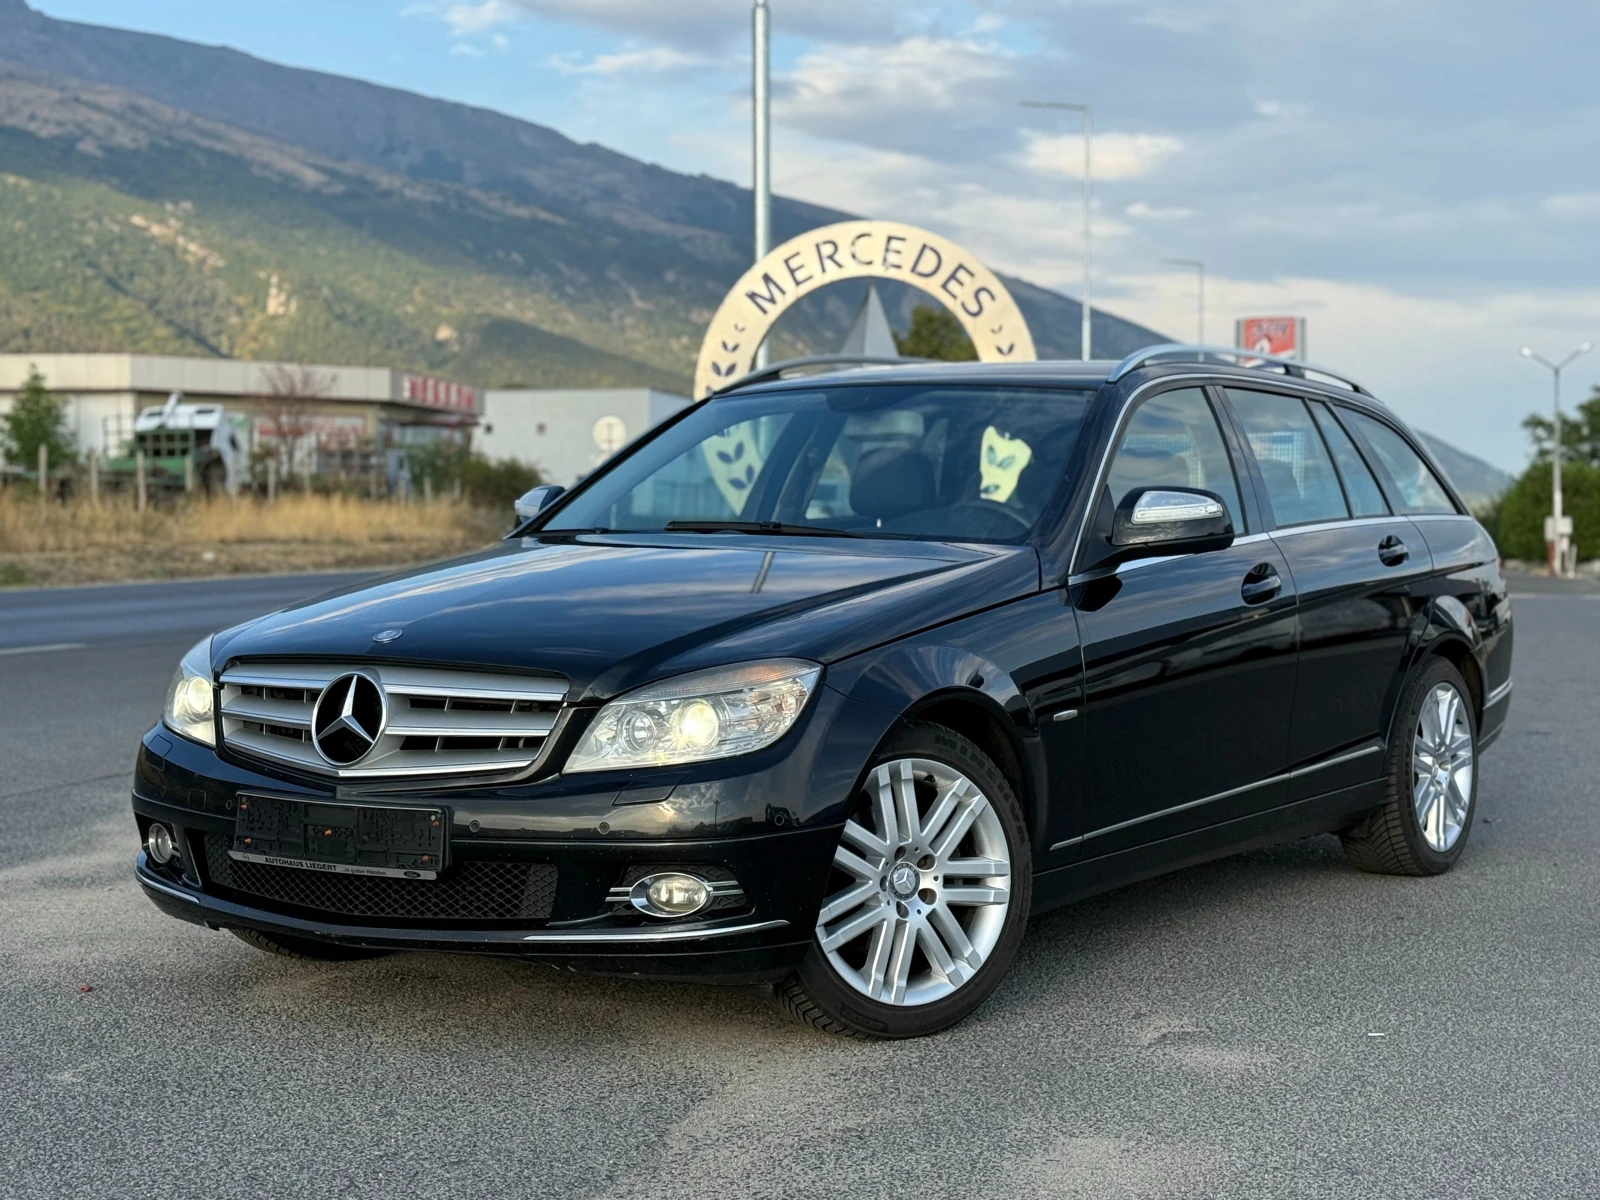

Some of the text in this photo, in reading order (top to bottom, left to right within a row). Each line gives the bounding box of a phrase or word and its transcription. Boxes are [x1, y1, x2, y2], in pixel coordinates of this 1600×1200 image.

[745, 232, 996, 319] MERCEDES
[264, 857, 337, 872] AUTOHAUS LIEGERT
